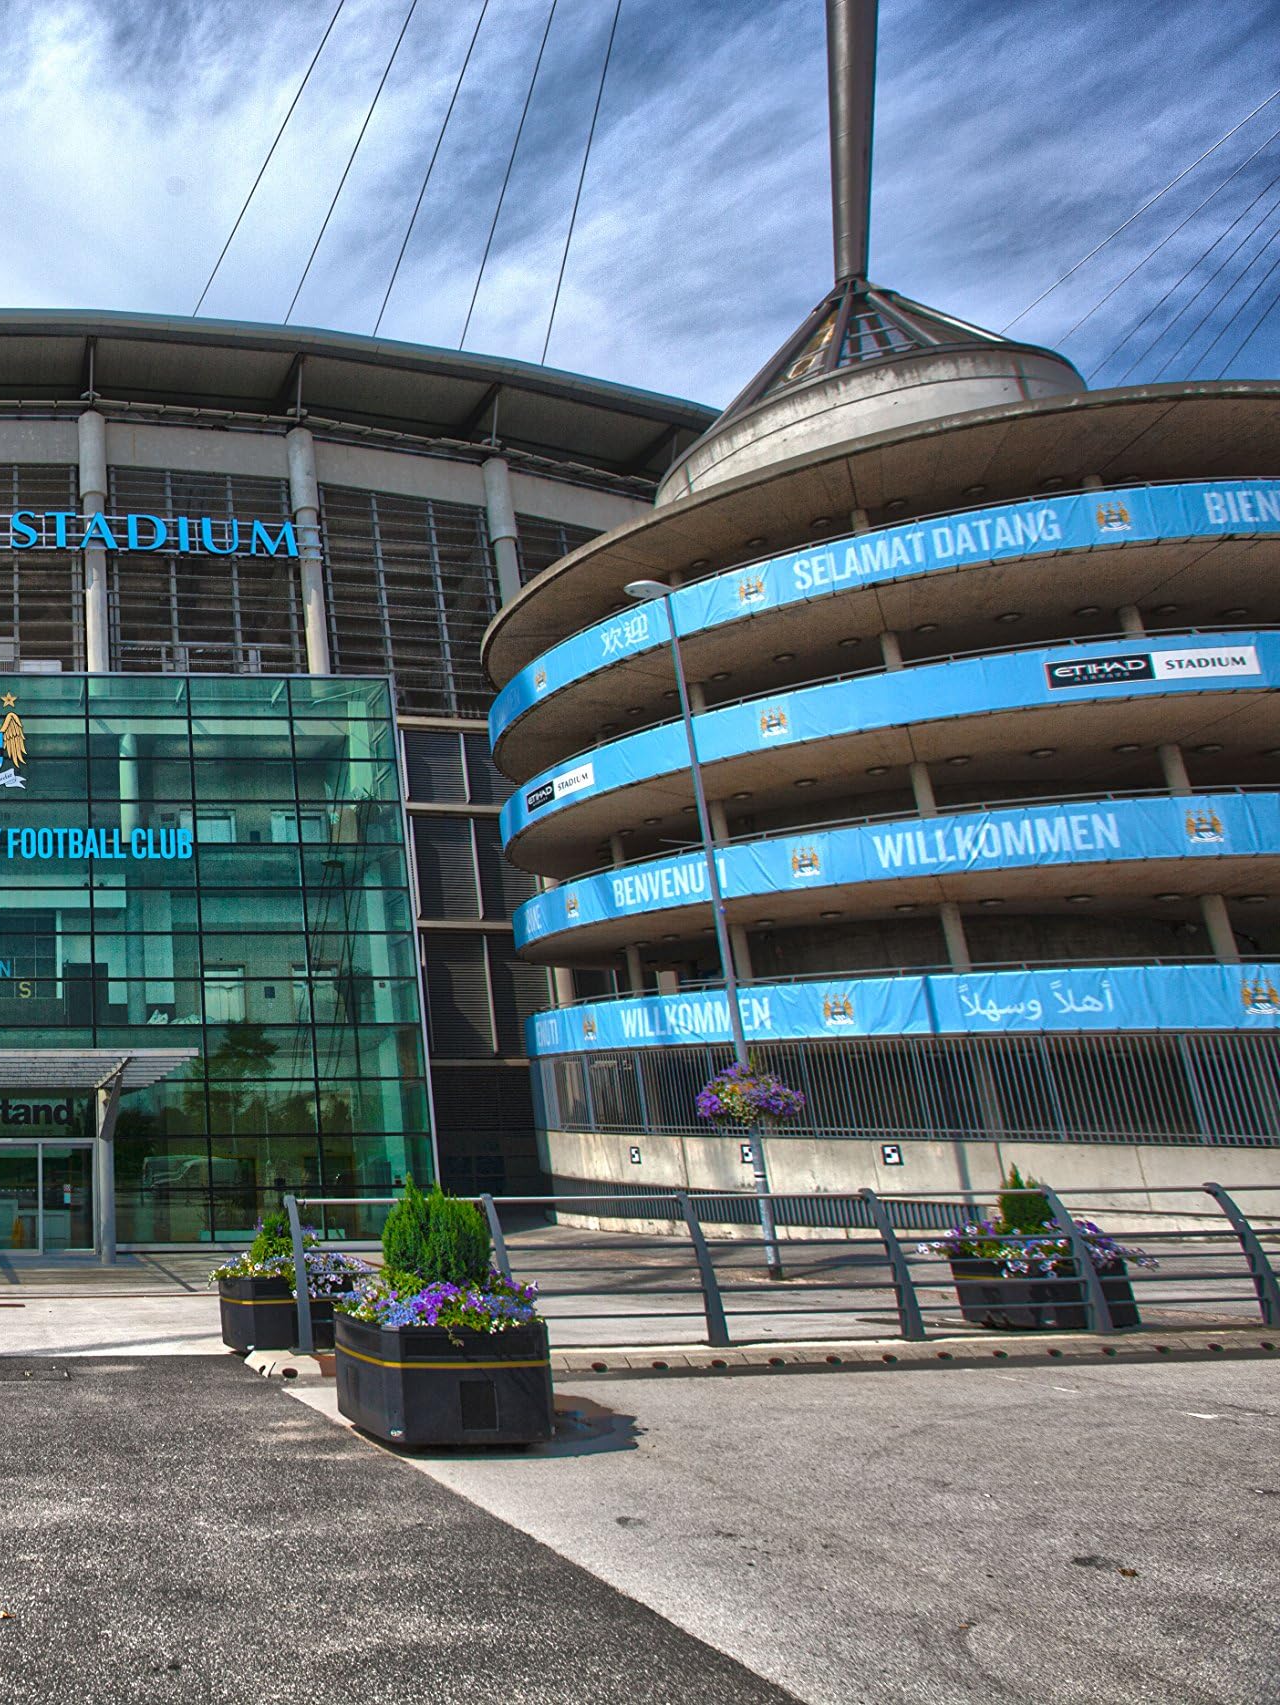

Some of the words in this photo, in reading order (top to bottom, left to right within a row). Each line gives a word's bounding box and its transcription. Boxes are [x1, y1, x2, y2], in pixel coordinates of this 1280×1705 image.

[10, 510, 299, 558] STADIUM
[793, 531, 926, 590] SELAMAT
[933, 508, 1062, 559] DATANG
[600, 613, 649, 657] 欢迎
[1054, 659, 1147, 678] ETIHAD
[1166, 655, 1246, 670] STADIUM
[528, 786, 553, 805] ETIHAD
[557, 772, 589, 791] STADIUM
[7, 827, 128, 860] FOOTBALL
[131, 827, 193, 860] CLUB
[872, 812, 1120, 869] WILLKOMMEN
[621, 997, 771, 1038] WILLKOMMEN
